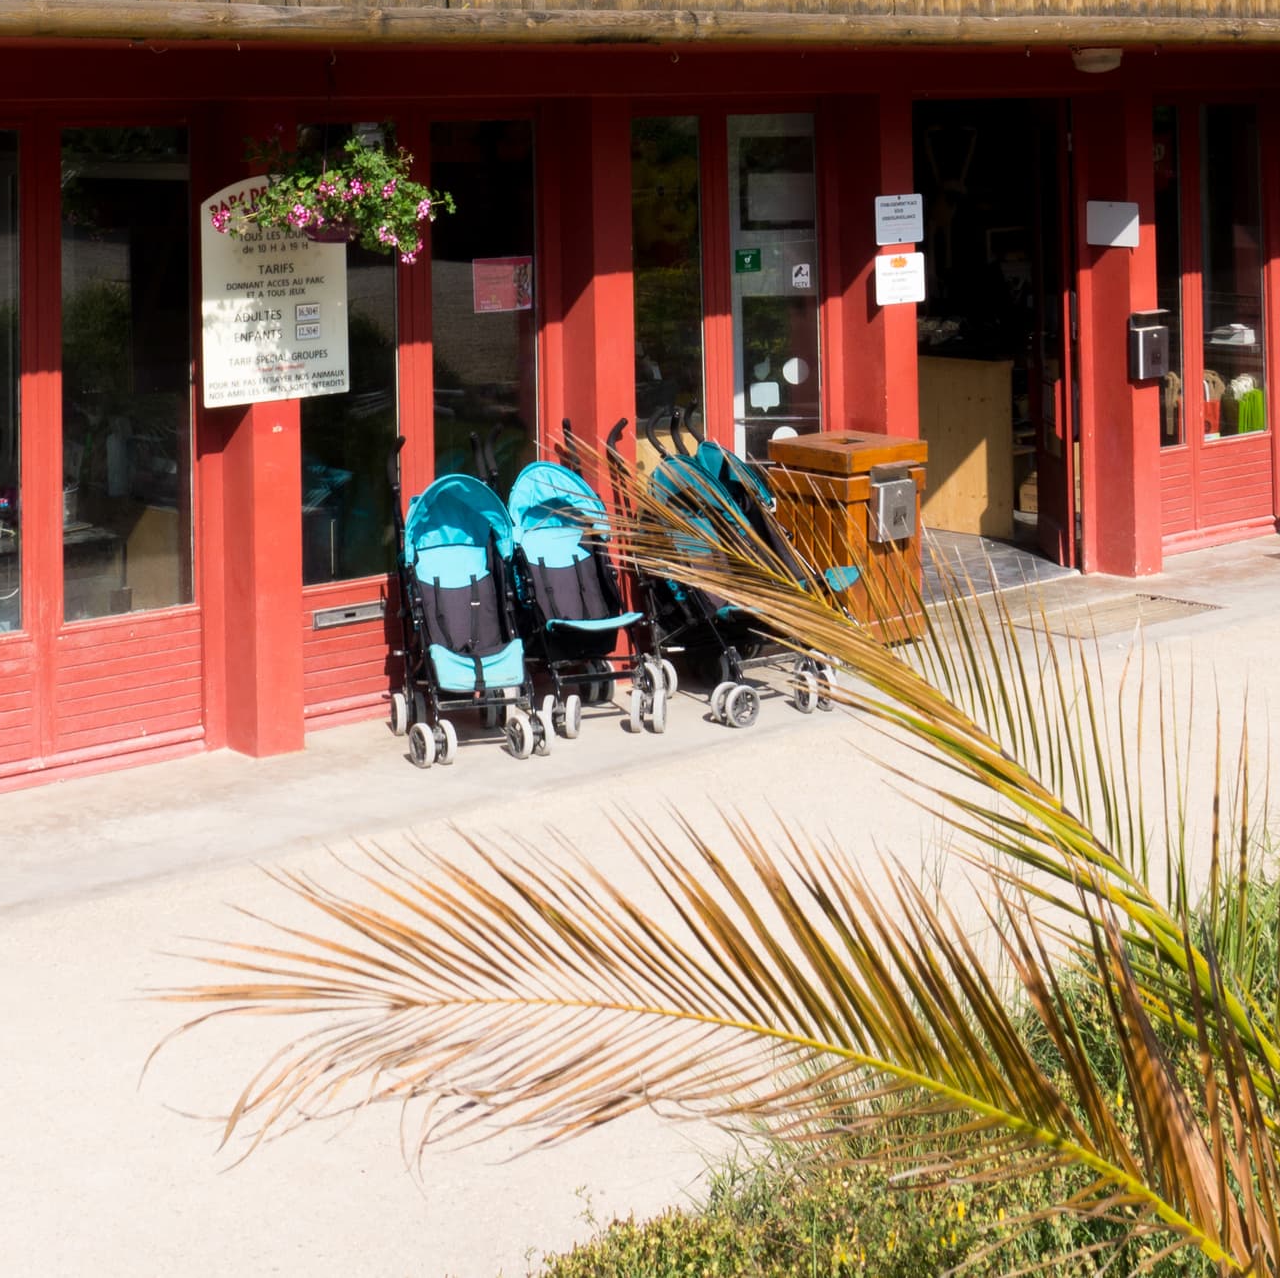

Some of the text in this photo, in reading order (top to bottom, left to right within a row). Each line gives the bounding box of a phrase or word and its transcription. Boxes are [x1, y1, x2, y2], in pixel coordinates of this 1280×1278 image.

[239, 229, 311, 241] TOUS LES JOUR
[242, 245, 254, 254] de
[270, 244, 277, 252] H
[258, 263, 295, 275] TARIFS
[226, 276, 325, 291] DONNANT ACCES AU PARC
[247, 290, 255, 298] ET
[267, 289, 286, 297] TOUS
[289, 287, 306, 296] JEUX
[234, 310, 282, 322] ADULTES
[234, 329, 283, 342] ENFANTS
[229, 349, 328, 367] TARIF SPECIAL GROUPES
[243, 379, 257, 387] PAS
[311, 370, 345, 379] ANIMAUX
[208, 392, 224, 400] NOS
[248, 388, 259, 396] LES
[311, 379, 345, 388] INTERDITS
